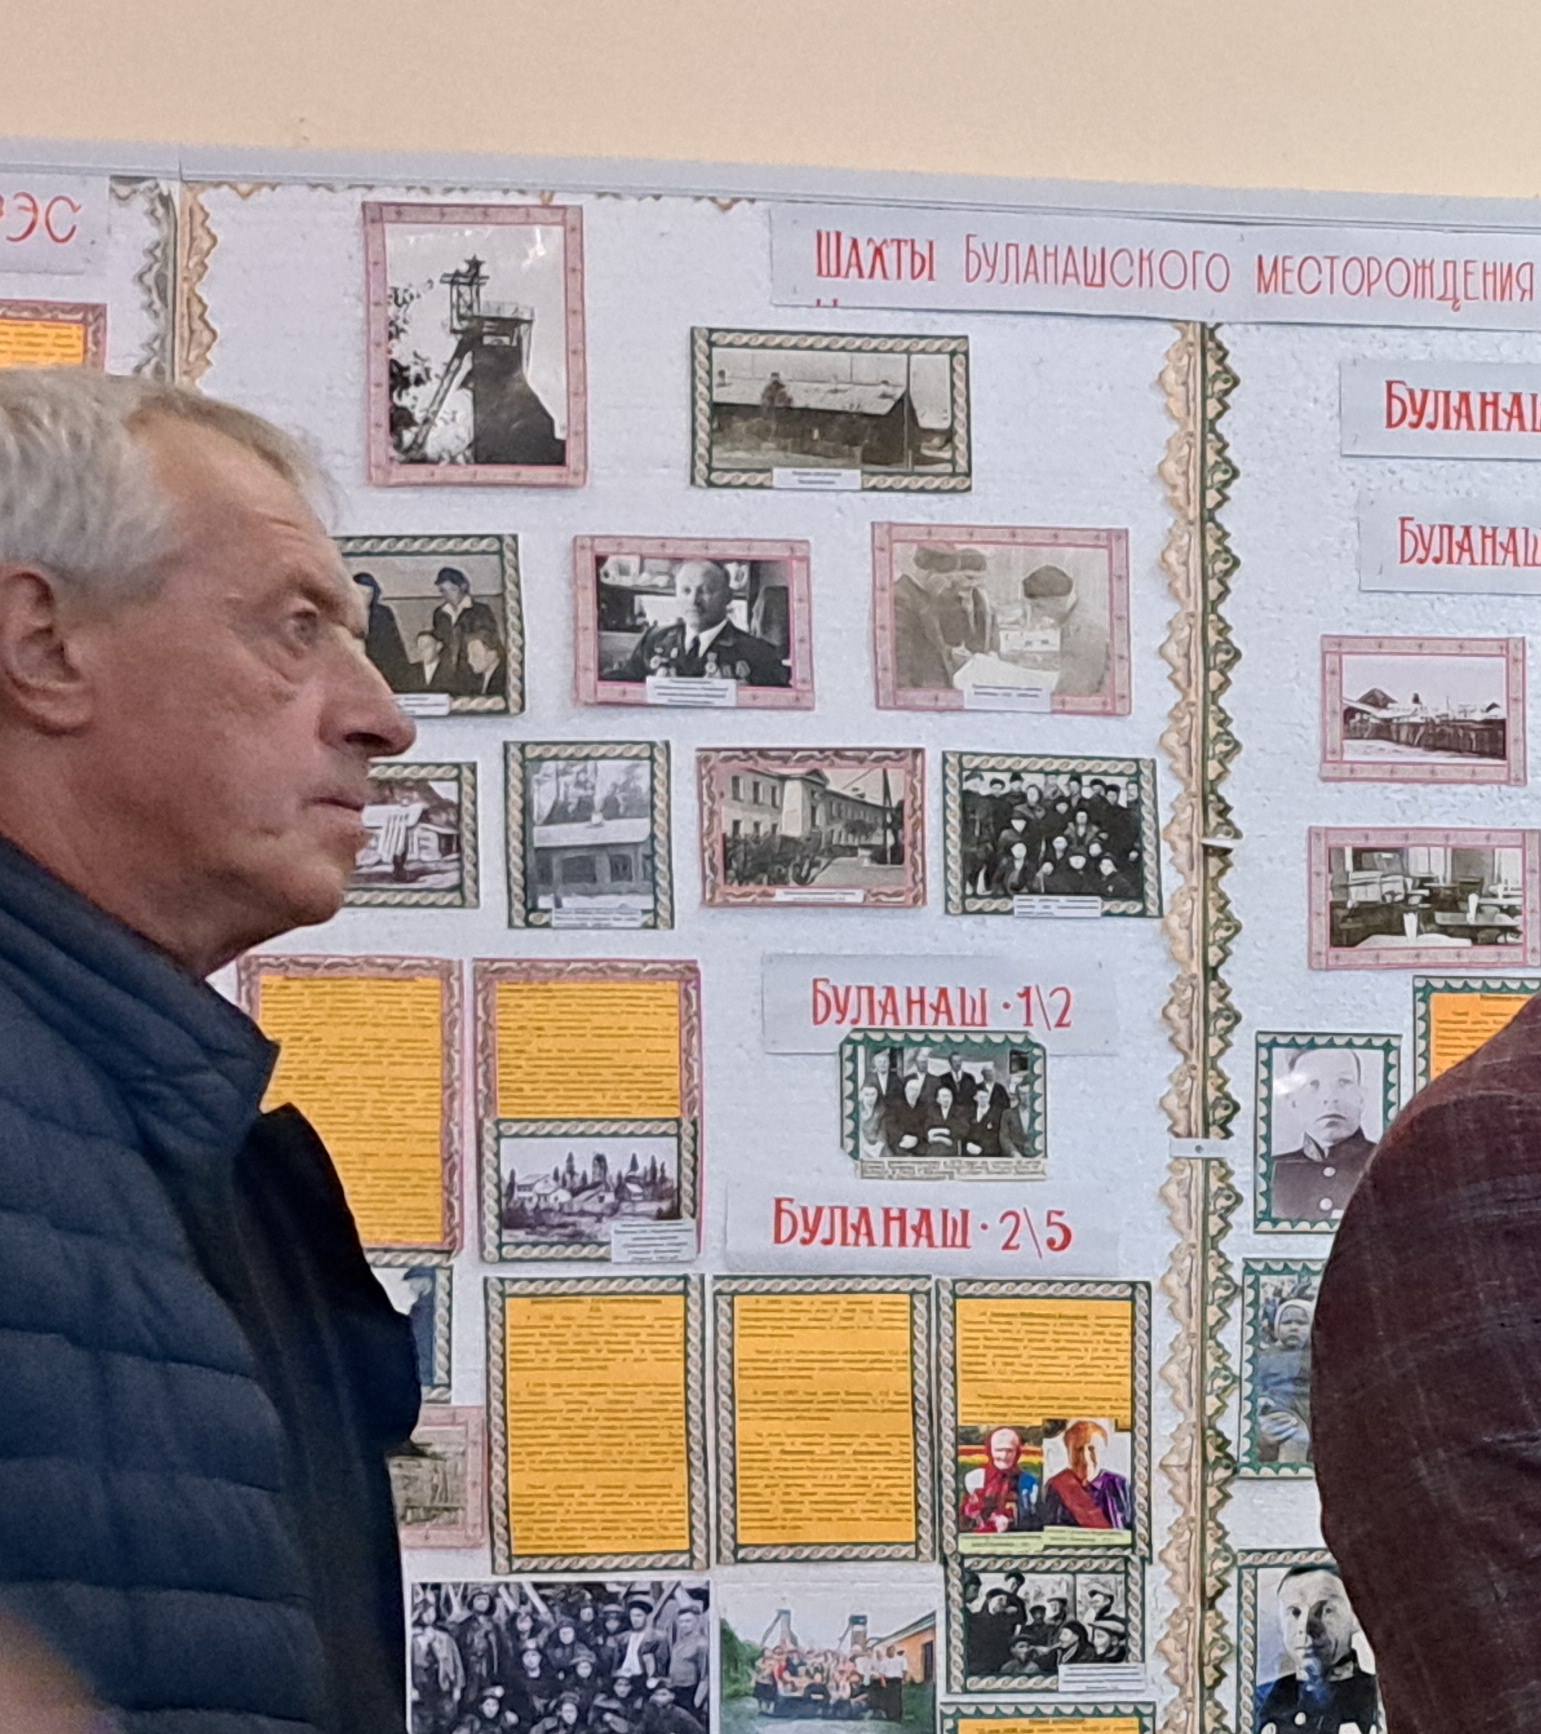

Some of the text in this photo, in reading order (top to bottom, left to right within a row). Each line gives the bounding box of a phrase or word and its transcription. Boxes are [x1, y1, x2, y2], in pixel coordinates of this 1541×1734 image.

[0, 190, 82, 244] ЭС
[816, 230, 1535, 312] ШАХТЫ БУЛАНАШСКОГО МЕСТОРОЖДЕНИЯ
[811, 977, 990, 1028] БУЛАНАШ
[772, 1196, 973, 1250] БУЛАНАШ
